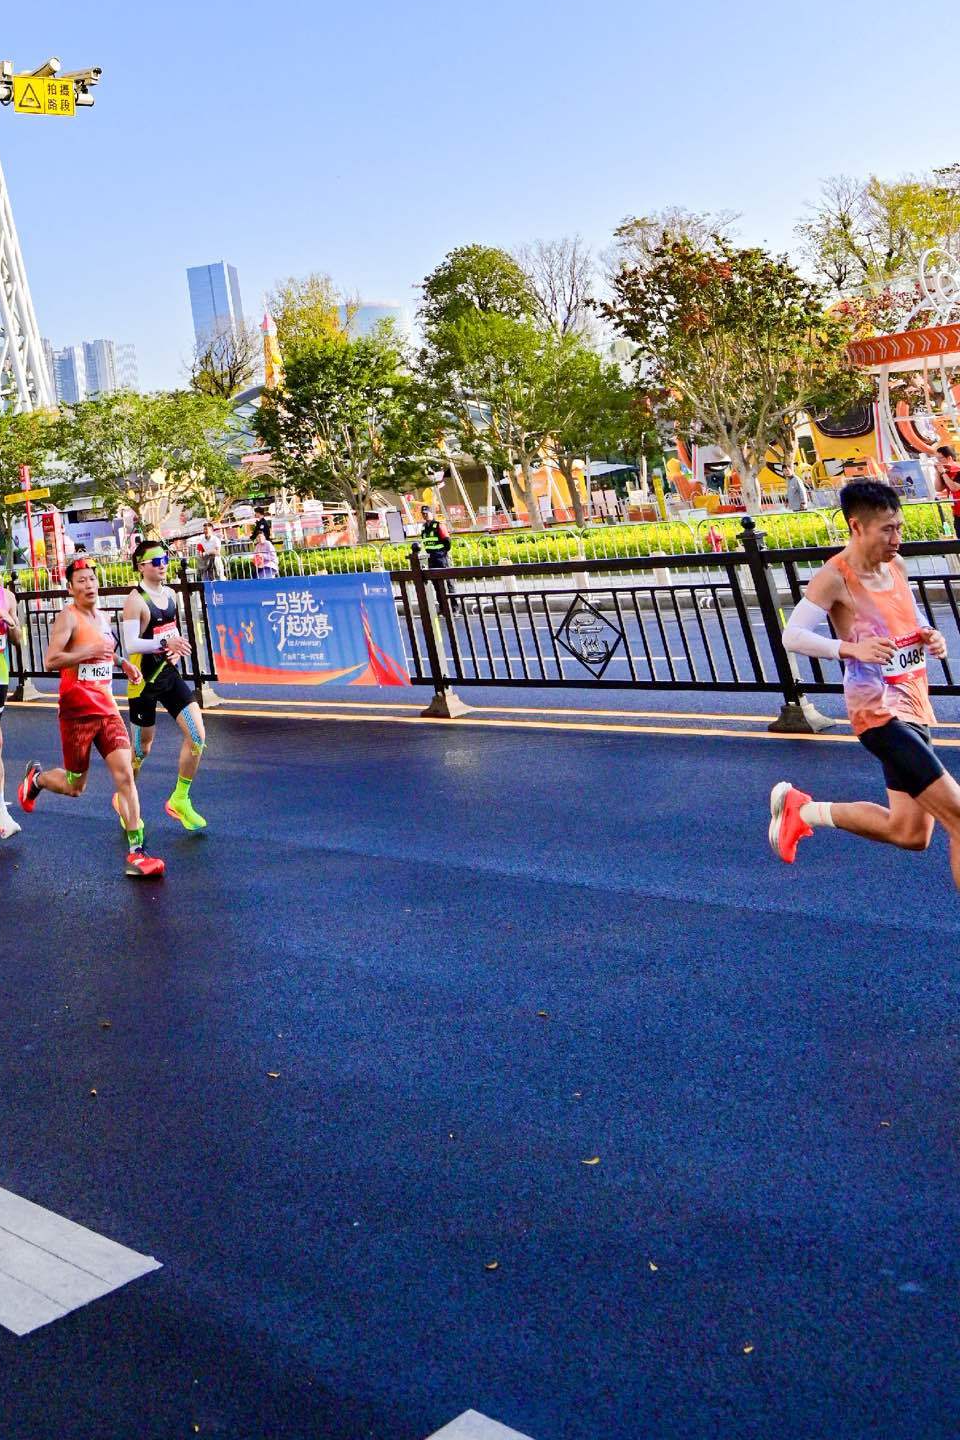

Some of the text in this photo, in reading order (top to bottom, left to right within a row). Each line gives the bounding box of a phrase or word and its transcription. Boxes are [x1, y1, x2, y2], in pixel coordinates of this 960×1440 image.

[47, 84, 70, 96] 拍摄
[47, 98, 71, 111] 路段
[261, 591, 320, 614] 一马当先
[92, 666, 110, 677] 1624
